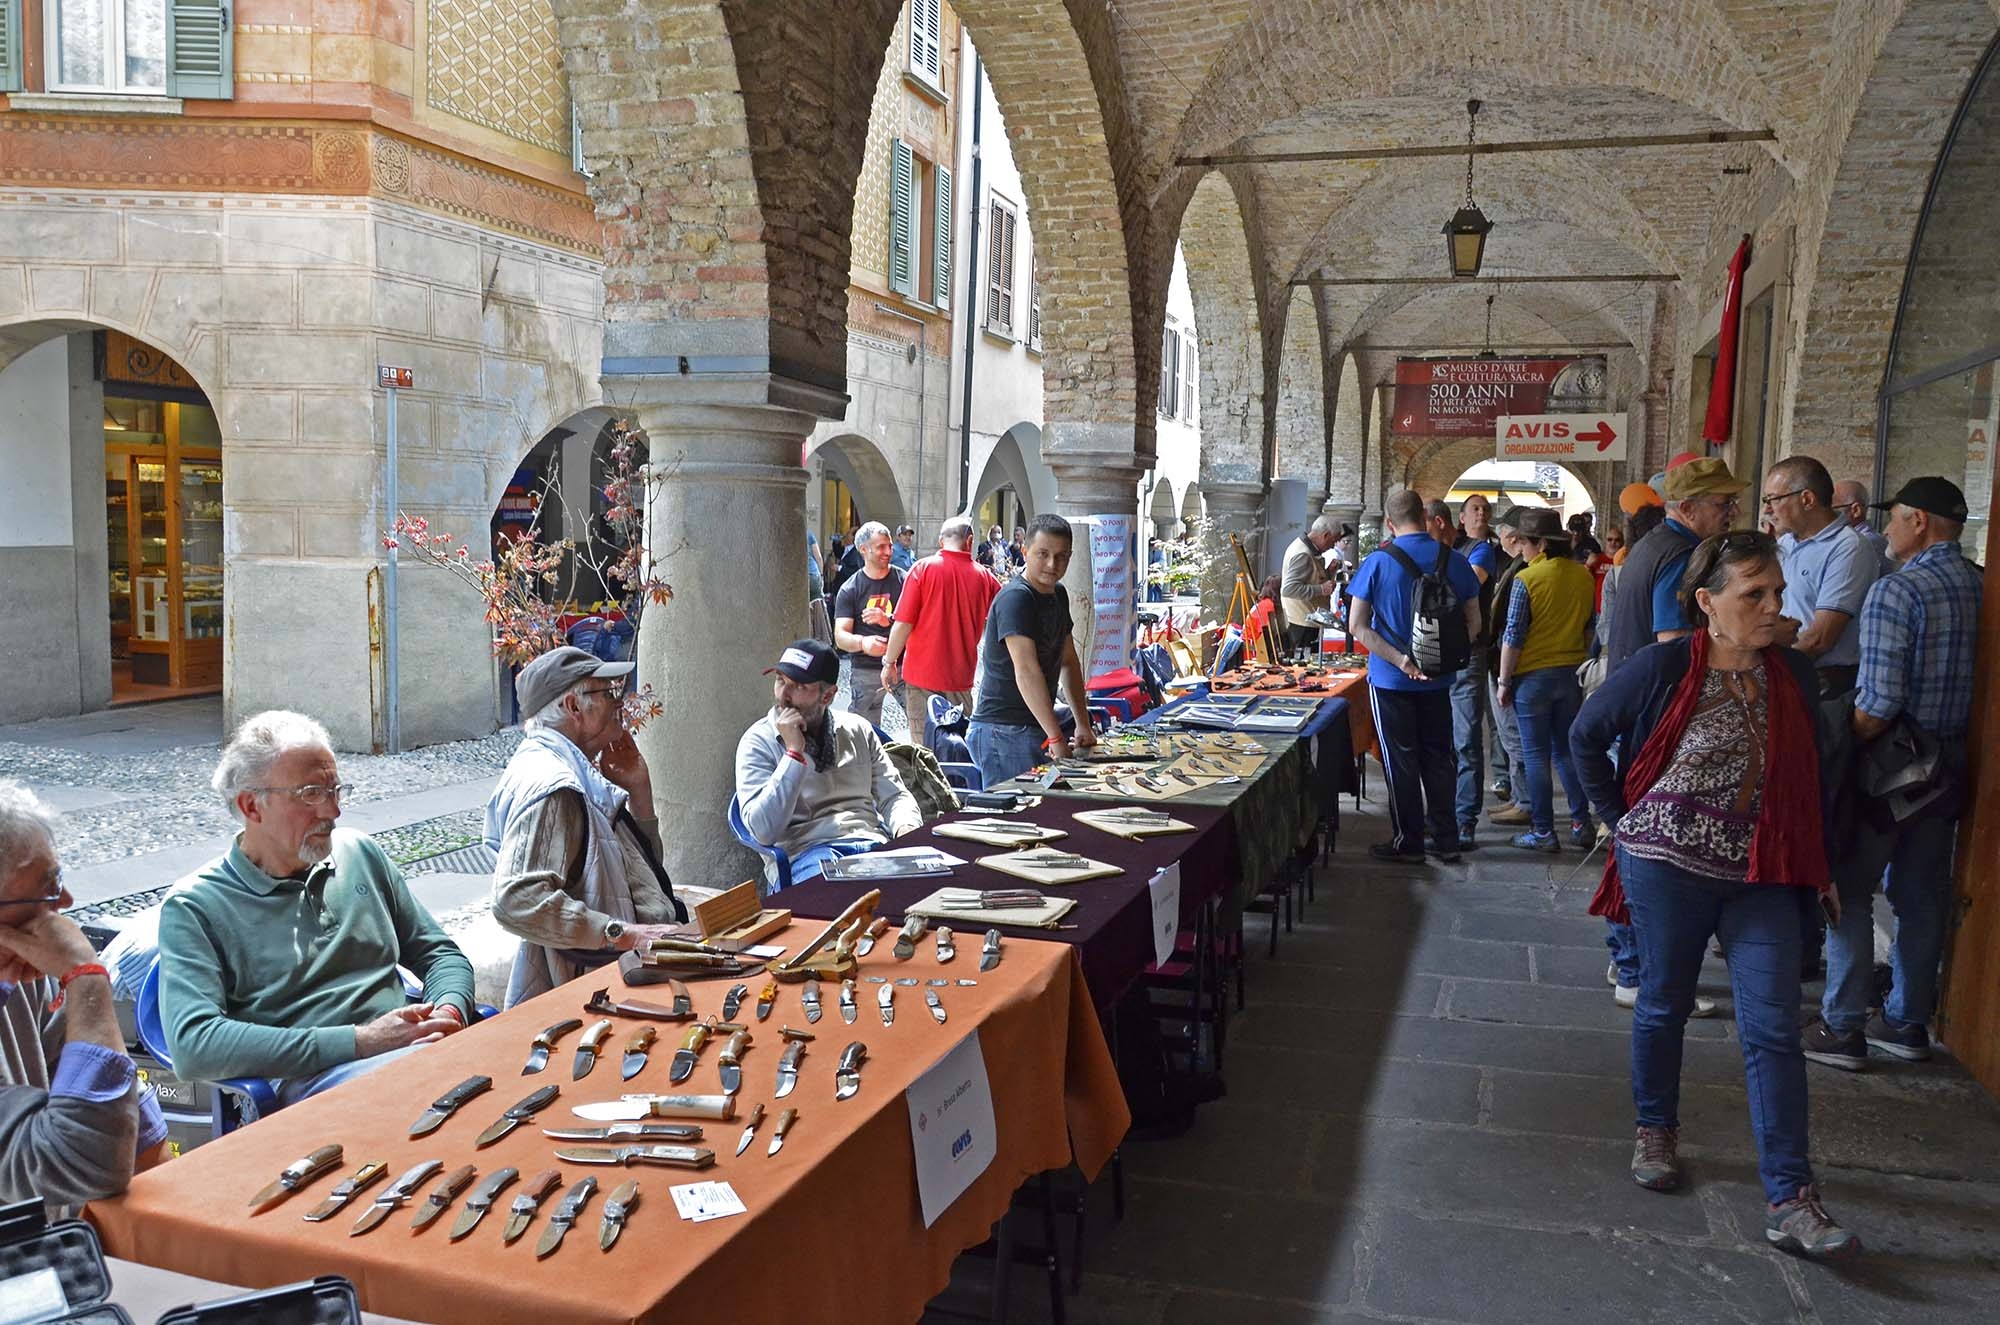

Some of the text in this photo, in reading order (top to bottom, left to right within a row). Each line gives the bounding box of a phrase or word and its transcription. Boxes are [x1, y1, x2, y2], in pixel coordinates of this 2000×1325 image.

[1450, 363, 1528, 373] MUSEO D'ARTE
[1450, 373, 1545, 382] E CULTURA SACRA
[1429, 384, 1515, 399] 500 ANNI
[1429, 398, 1497, 406] DI ARTE SACRA
[1429, 406, 1482, 414] IN MOSTRA
[1505, 422, 1570, 439] AVIS
[1504, 442, 1576, 456] ORGANIZZAZIONE
